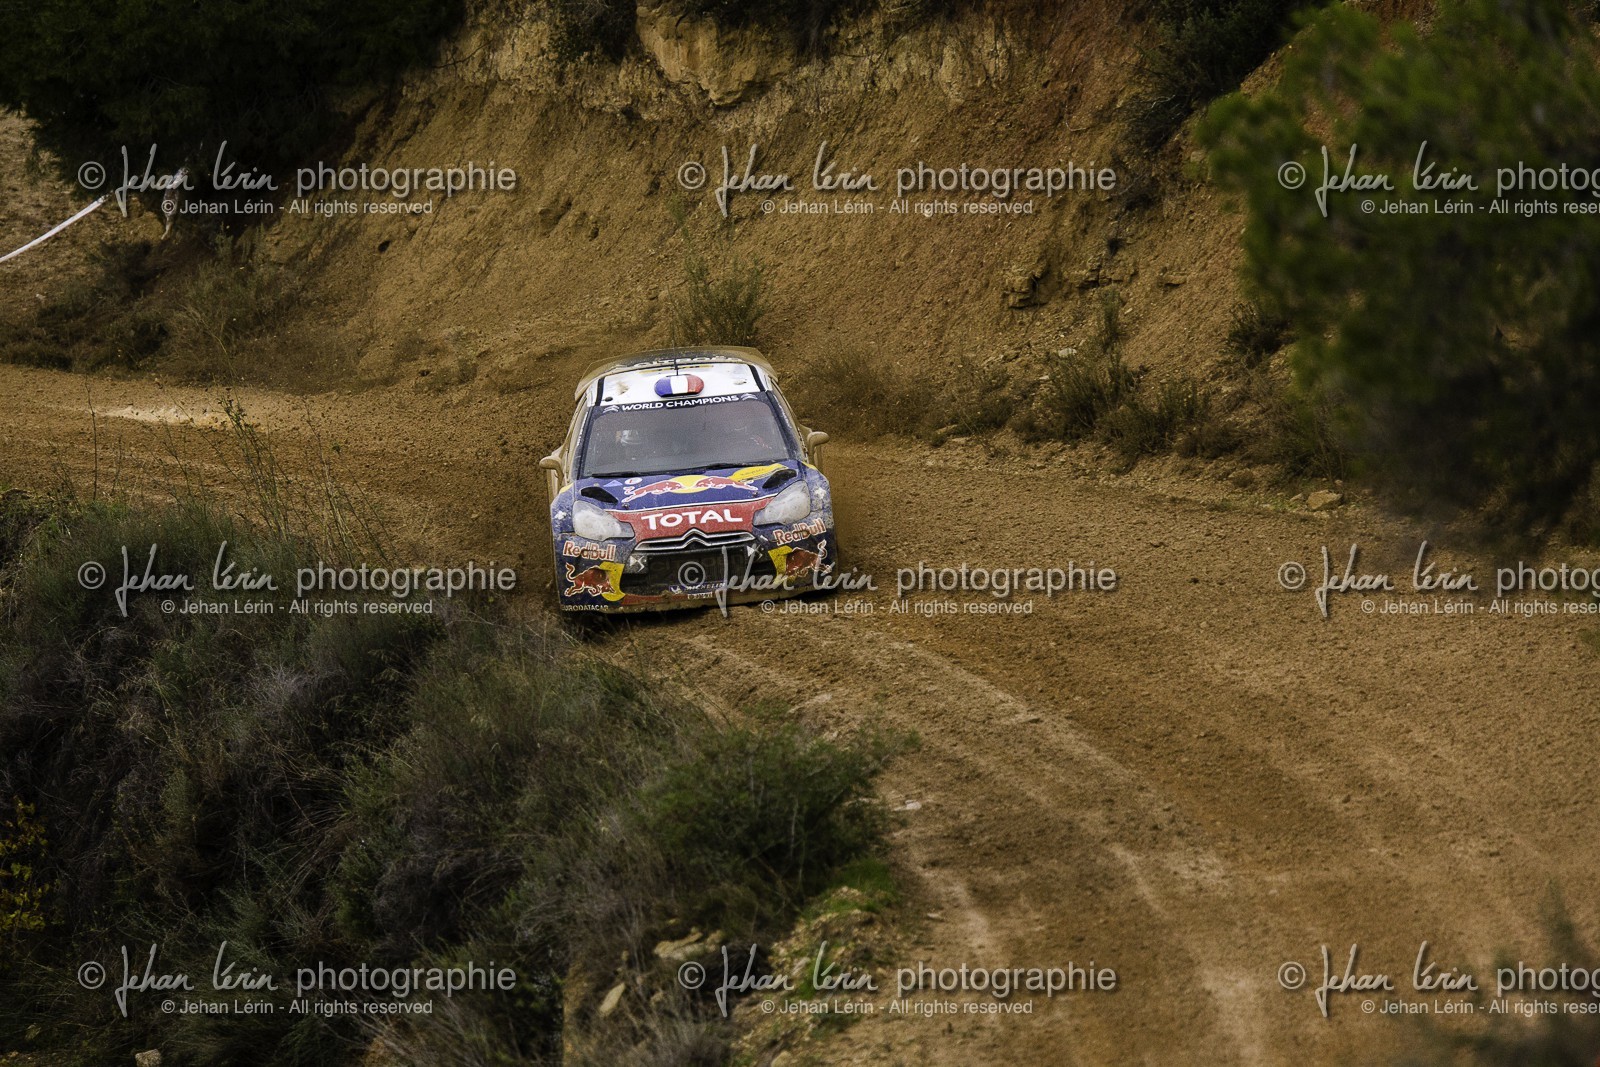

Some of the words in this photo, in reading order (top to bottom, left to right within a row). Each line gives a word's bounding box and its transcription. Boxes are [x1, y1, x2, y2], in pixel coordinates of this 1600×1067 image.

[621, 402, 664, 411] WORLD
[666, 395, 740, 408] CHAMPIONS
[641, 508, 743, 531] TOTAL
